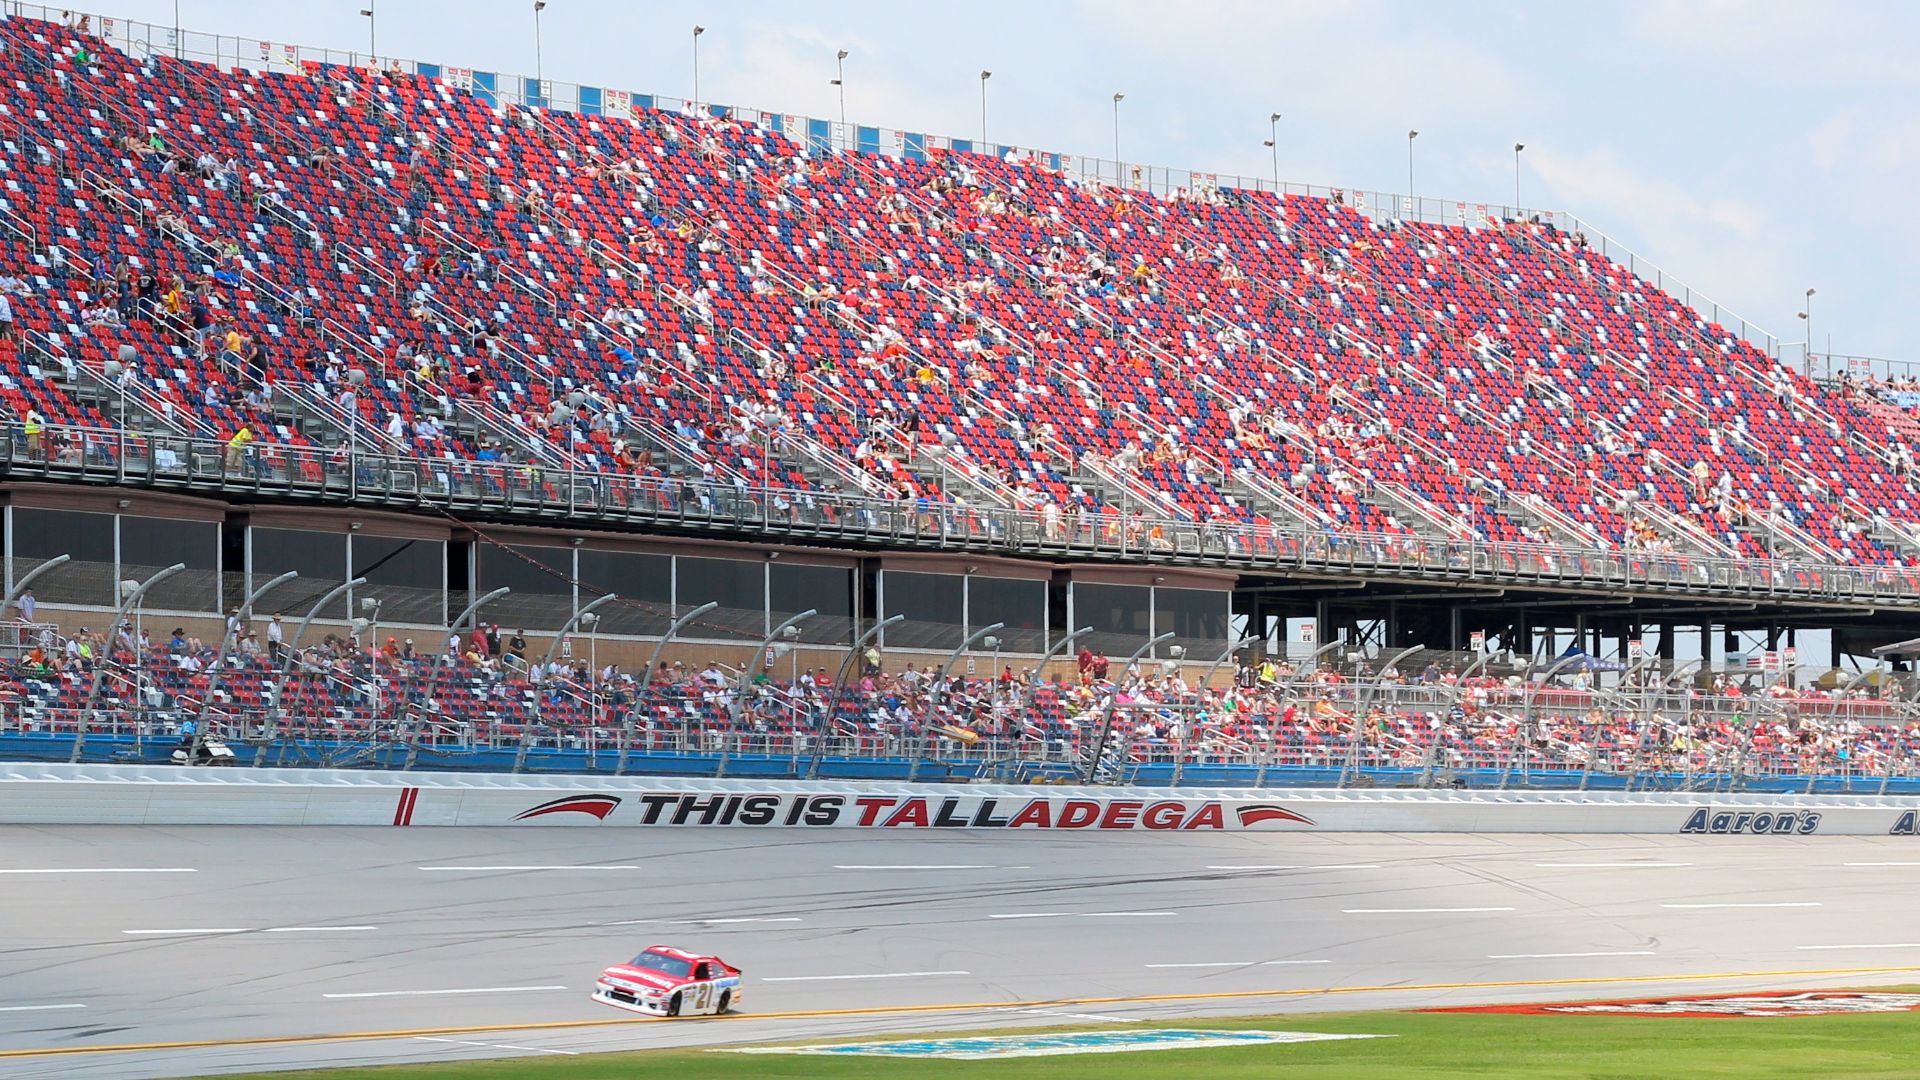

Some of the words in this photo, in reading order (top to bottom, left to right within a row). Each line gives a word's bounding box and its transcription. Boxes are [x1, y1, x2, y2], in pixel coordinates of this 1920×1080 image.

[639, 793, 782, 825] THIS
[784, 794, 847, 826] IS
[855, 795, 1225, 830] TALLADEGA
[1680, 807, 1822, 834] Aaron's
[696, 982, 713, 1009] 21
